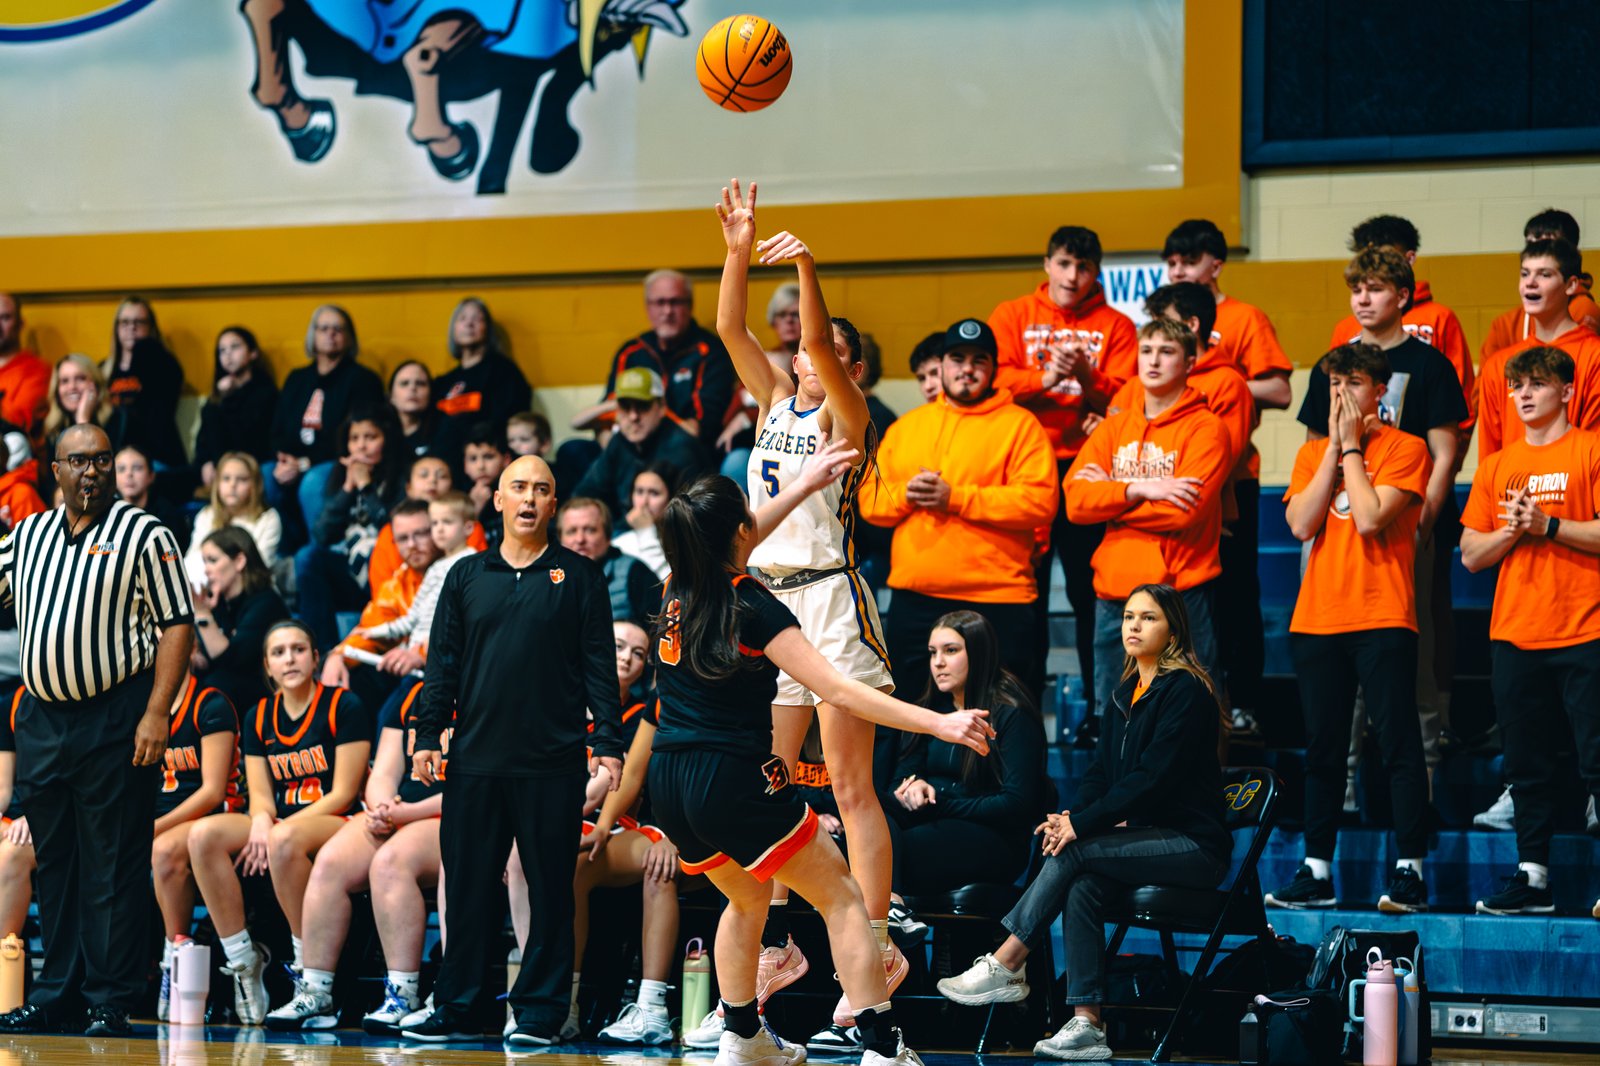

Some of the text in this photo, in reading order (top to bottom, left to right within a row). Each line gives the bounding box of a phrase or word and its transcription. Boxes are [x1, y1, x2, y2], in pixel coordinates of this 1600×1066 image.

[762, 459, 780, 498] 5
[1528, 472, 1569, 494] BYRON
[160, 746, 200, 771] RON
